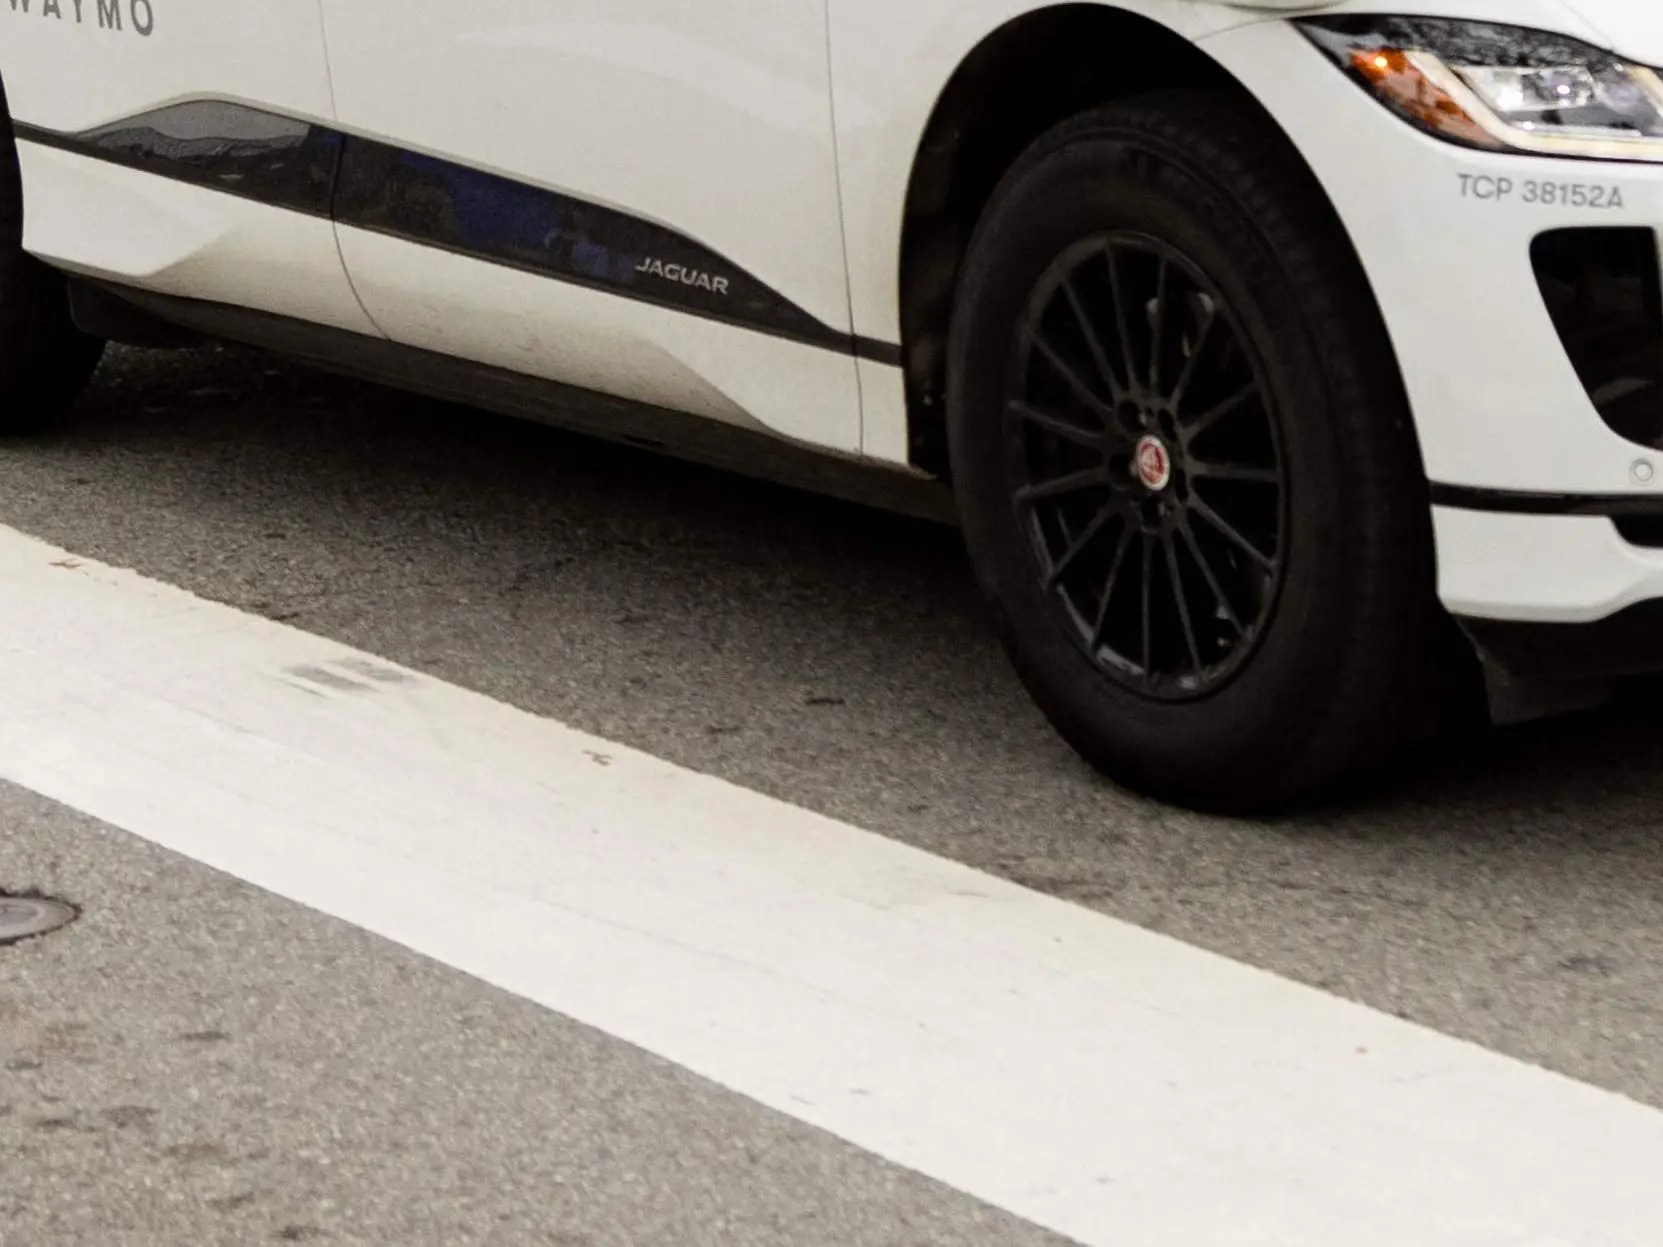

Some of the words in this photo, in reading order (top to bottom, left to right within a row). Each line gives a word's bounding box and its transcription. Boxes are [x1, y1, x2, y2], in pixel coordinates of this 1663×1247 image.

[1457, 173, 1514, 201] TCP
[1522, 180, 1625, 209] 38152A
[634, 257, 729, 295] JAGUAR
